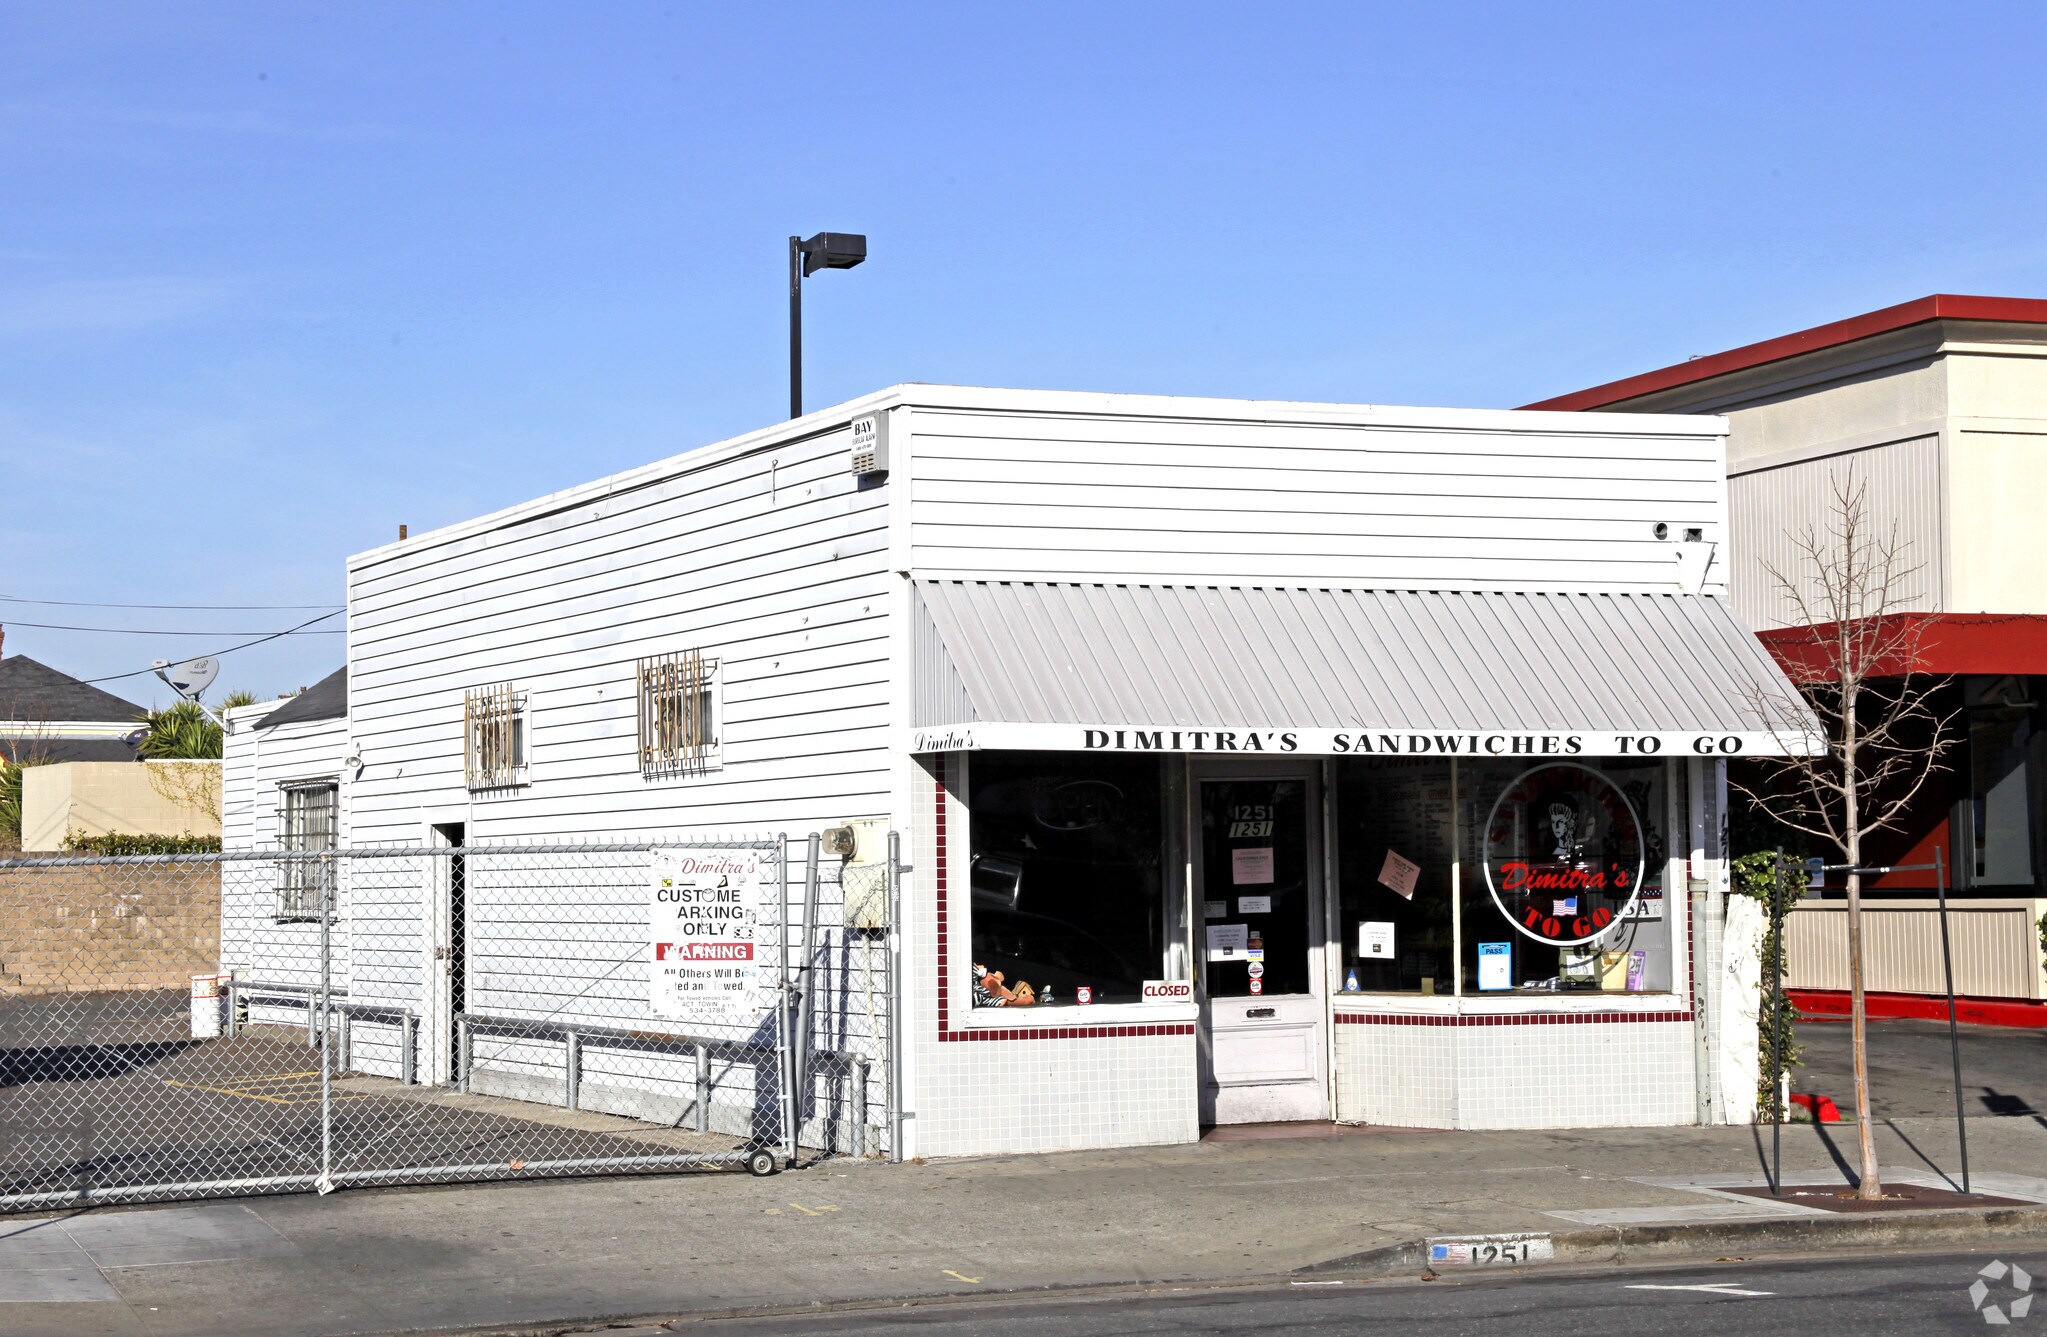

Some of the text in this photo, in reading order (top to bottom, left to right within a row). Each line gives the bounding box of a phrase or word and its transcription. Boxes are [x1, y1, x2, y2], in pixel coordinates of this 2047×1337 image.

[855, 421, 873, 435] BAY
[1085, 730, 1743, 754] DIMITRA'S SANDWICHES TO GO
[1234, 805, 1274, 820] 1251
[1234, 822, 1269, 836] 1251
[682, 857, 755, 874] Dimitra's
[1501, 861, 1630, 890] Dimitra's
[657, 888, 741, 903] CUSTOME
[677, 906, 743, 919] ARKING
[1524, 905, 1612, 937] TO GO
[679, 968, 712, 978] Others
[714, 968, 732, 978] Will
[692, 981, 706, 991] an
[1143, 985, 1190, 997] CLOSED
[1471, 1244, 1528, 1265] 1251
